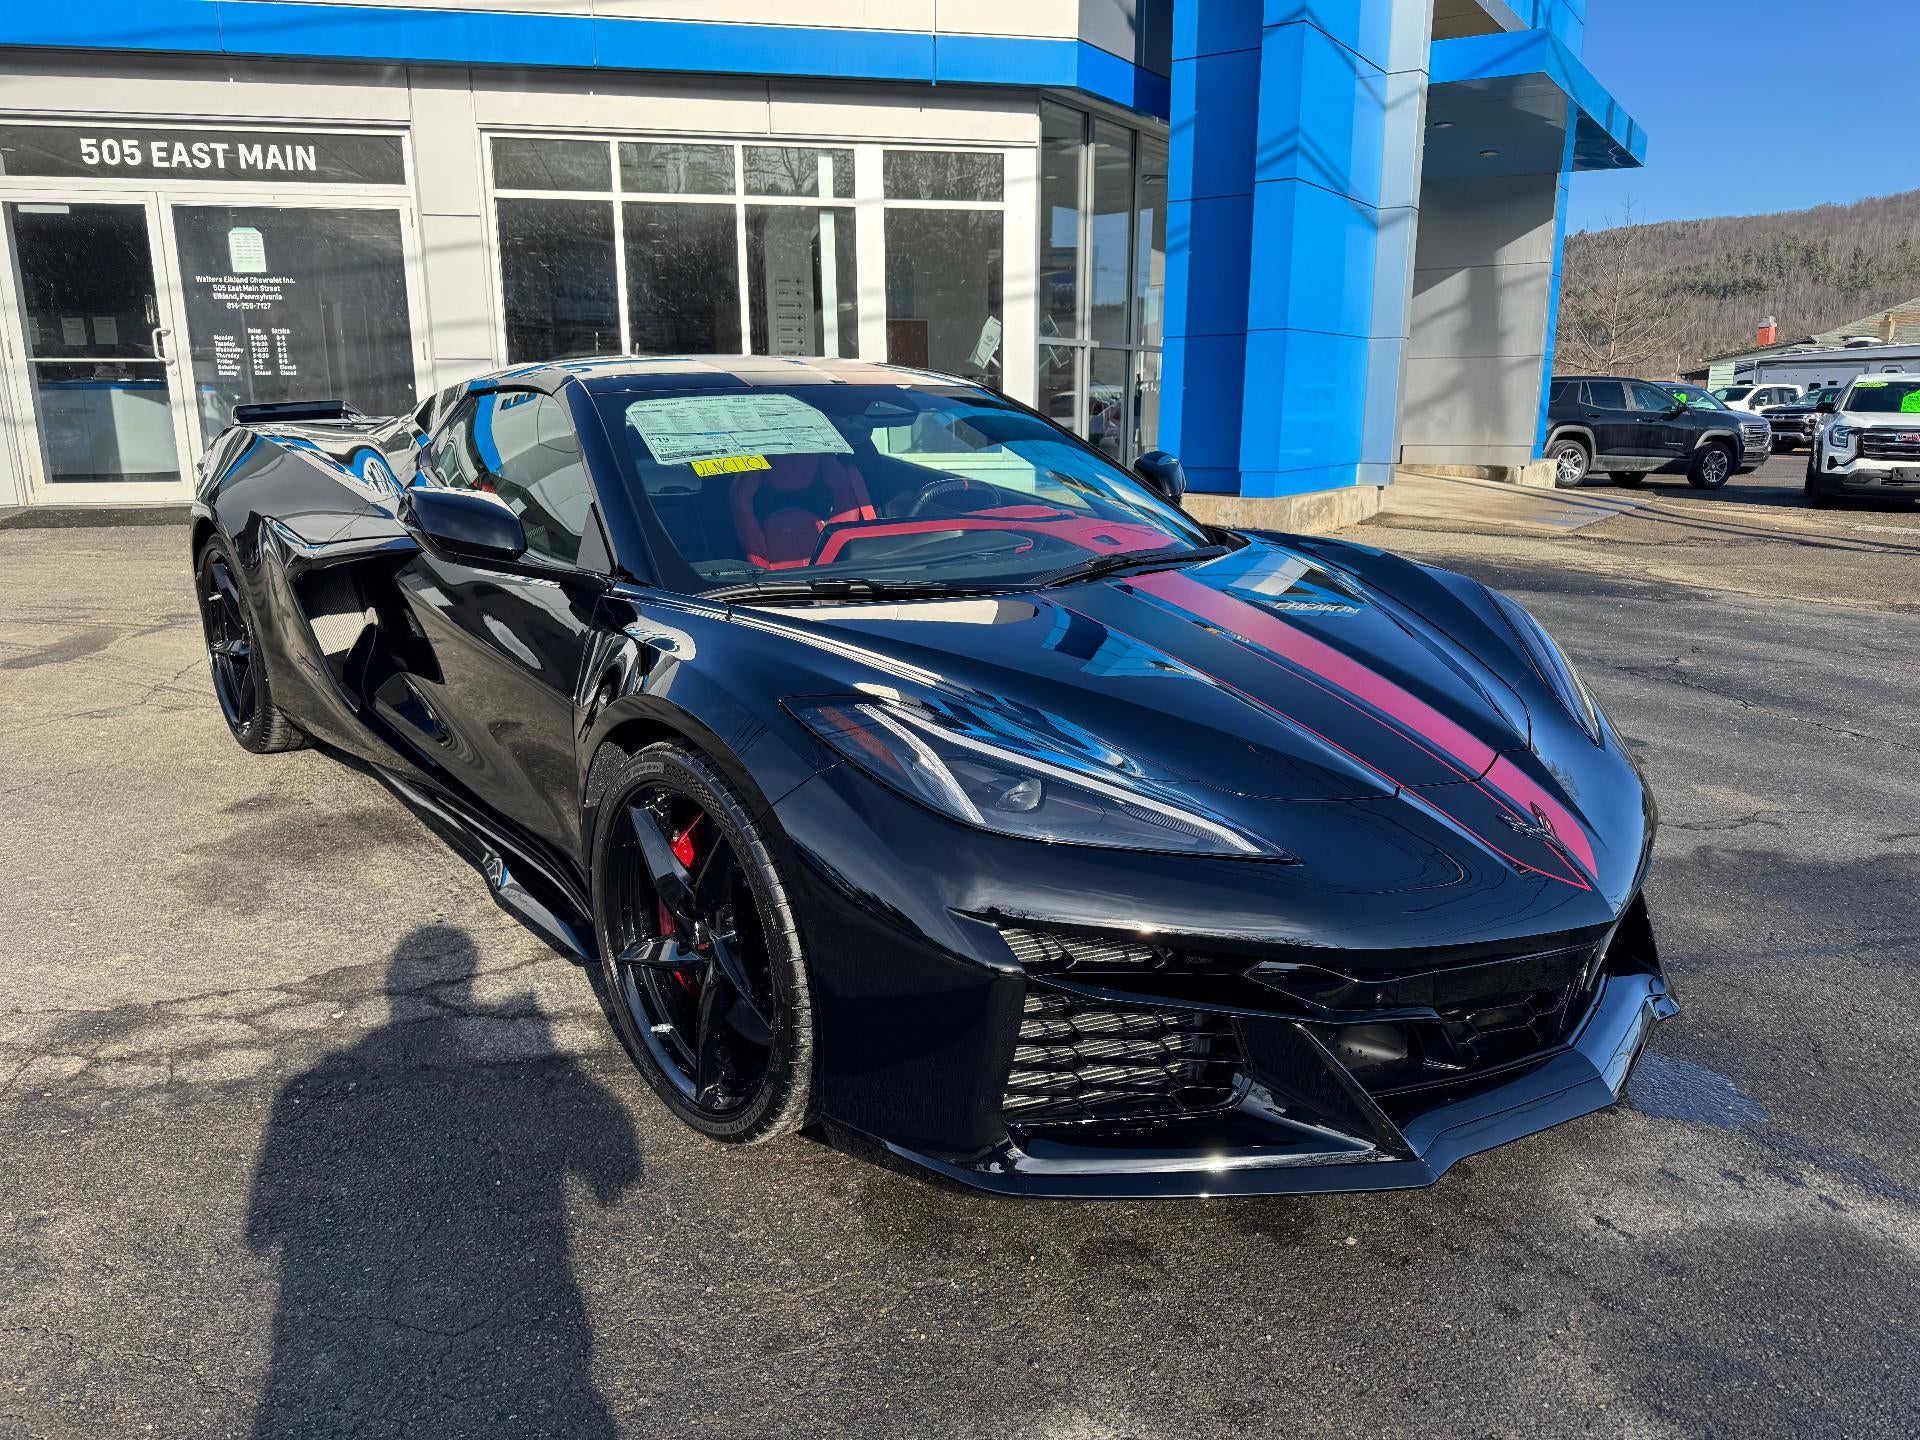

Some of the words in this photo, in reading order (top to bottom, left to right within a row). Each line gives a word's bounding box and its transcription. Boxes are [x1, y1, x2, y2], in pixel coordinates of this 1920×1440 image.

[79, 138, 142, 166] 505
[150, 141, 229, 169] EAST
[237, 143, 317, 171] MAIN
[195, 275, 223, 283] Walters
[223, 276, 249, 284] Elkland
[249, 276, 282, 284] Chevrolet
[282, 276, 296, 284] Inc.
[212, 284, 227, 292] 505
[227, 284, 242, 292] East
[242, 284, 259, 292] Main
[260, 284, 281, 292] Street
[239, 292, 283, 302] Pennsylvania
